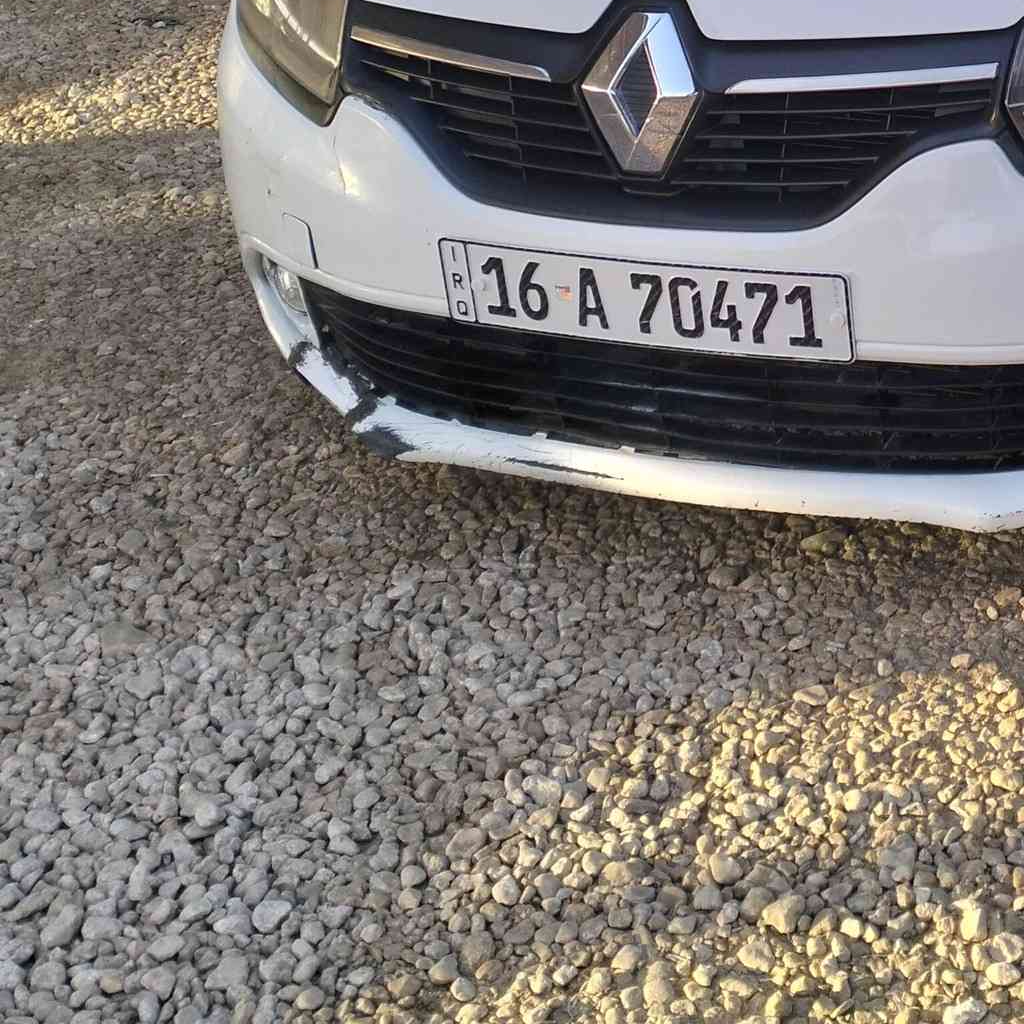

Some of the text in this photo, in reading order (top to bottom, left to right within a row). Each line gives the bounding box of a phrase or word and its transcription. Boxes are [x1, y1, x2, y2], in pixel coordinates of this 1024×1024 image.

[481, 256, 823, 348] 16 A 70471
